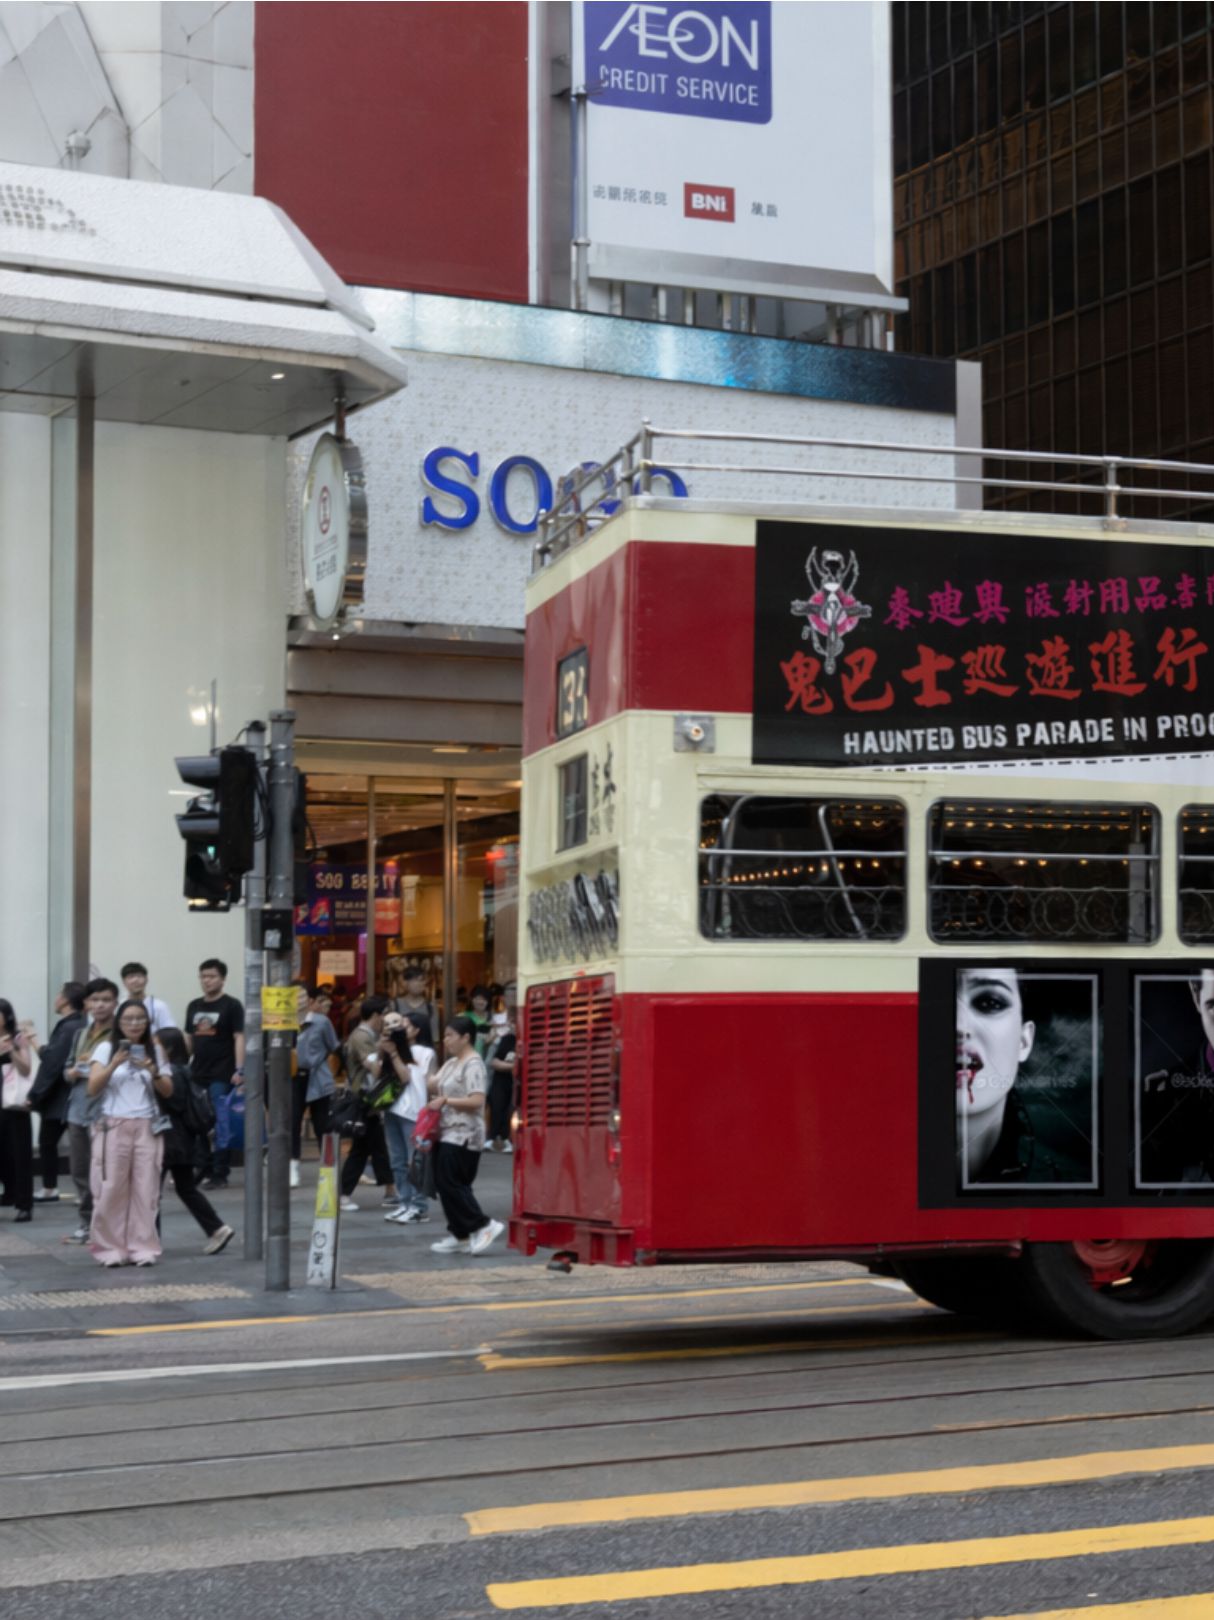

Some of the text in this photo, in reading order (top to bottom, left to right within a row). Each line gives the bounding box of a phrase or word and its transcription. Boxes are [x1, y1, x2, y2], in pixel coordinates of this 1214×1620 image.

[600, 65, 759, 106] CREDIT SERVICE
[843, 726, 955, 755] HAUNTED
[962, 724, 1008, 750] BUS
[1016, 717, 1115, 747] PARADE
[1123, 717, 1147, 741] IN
